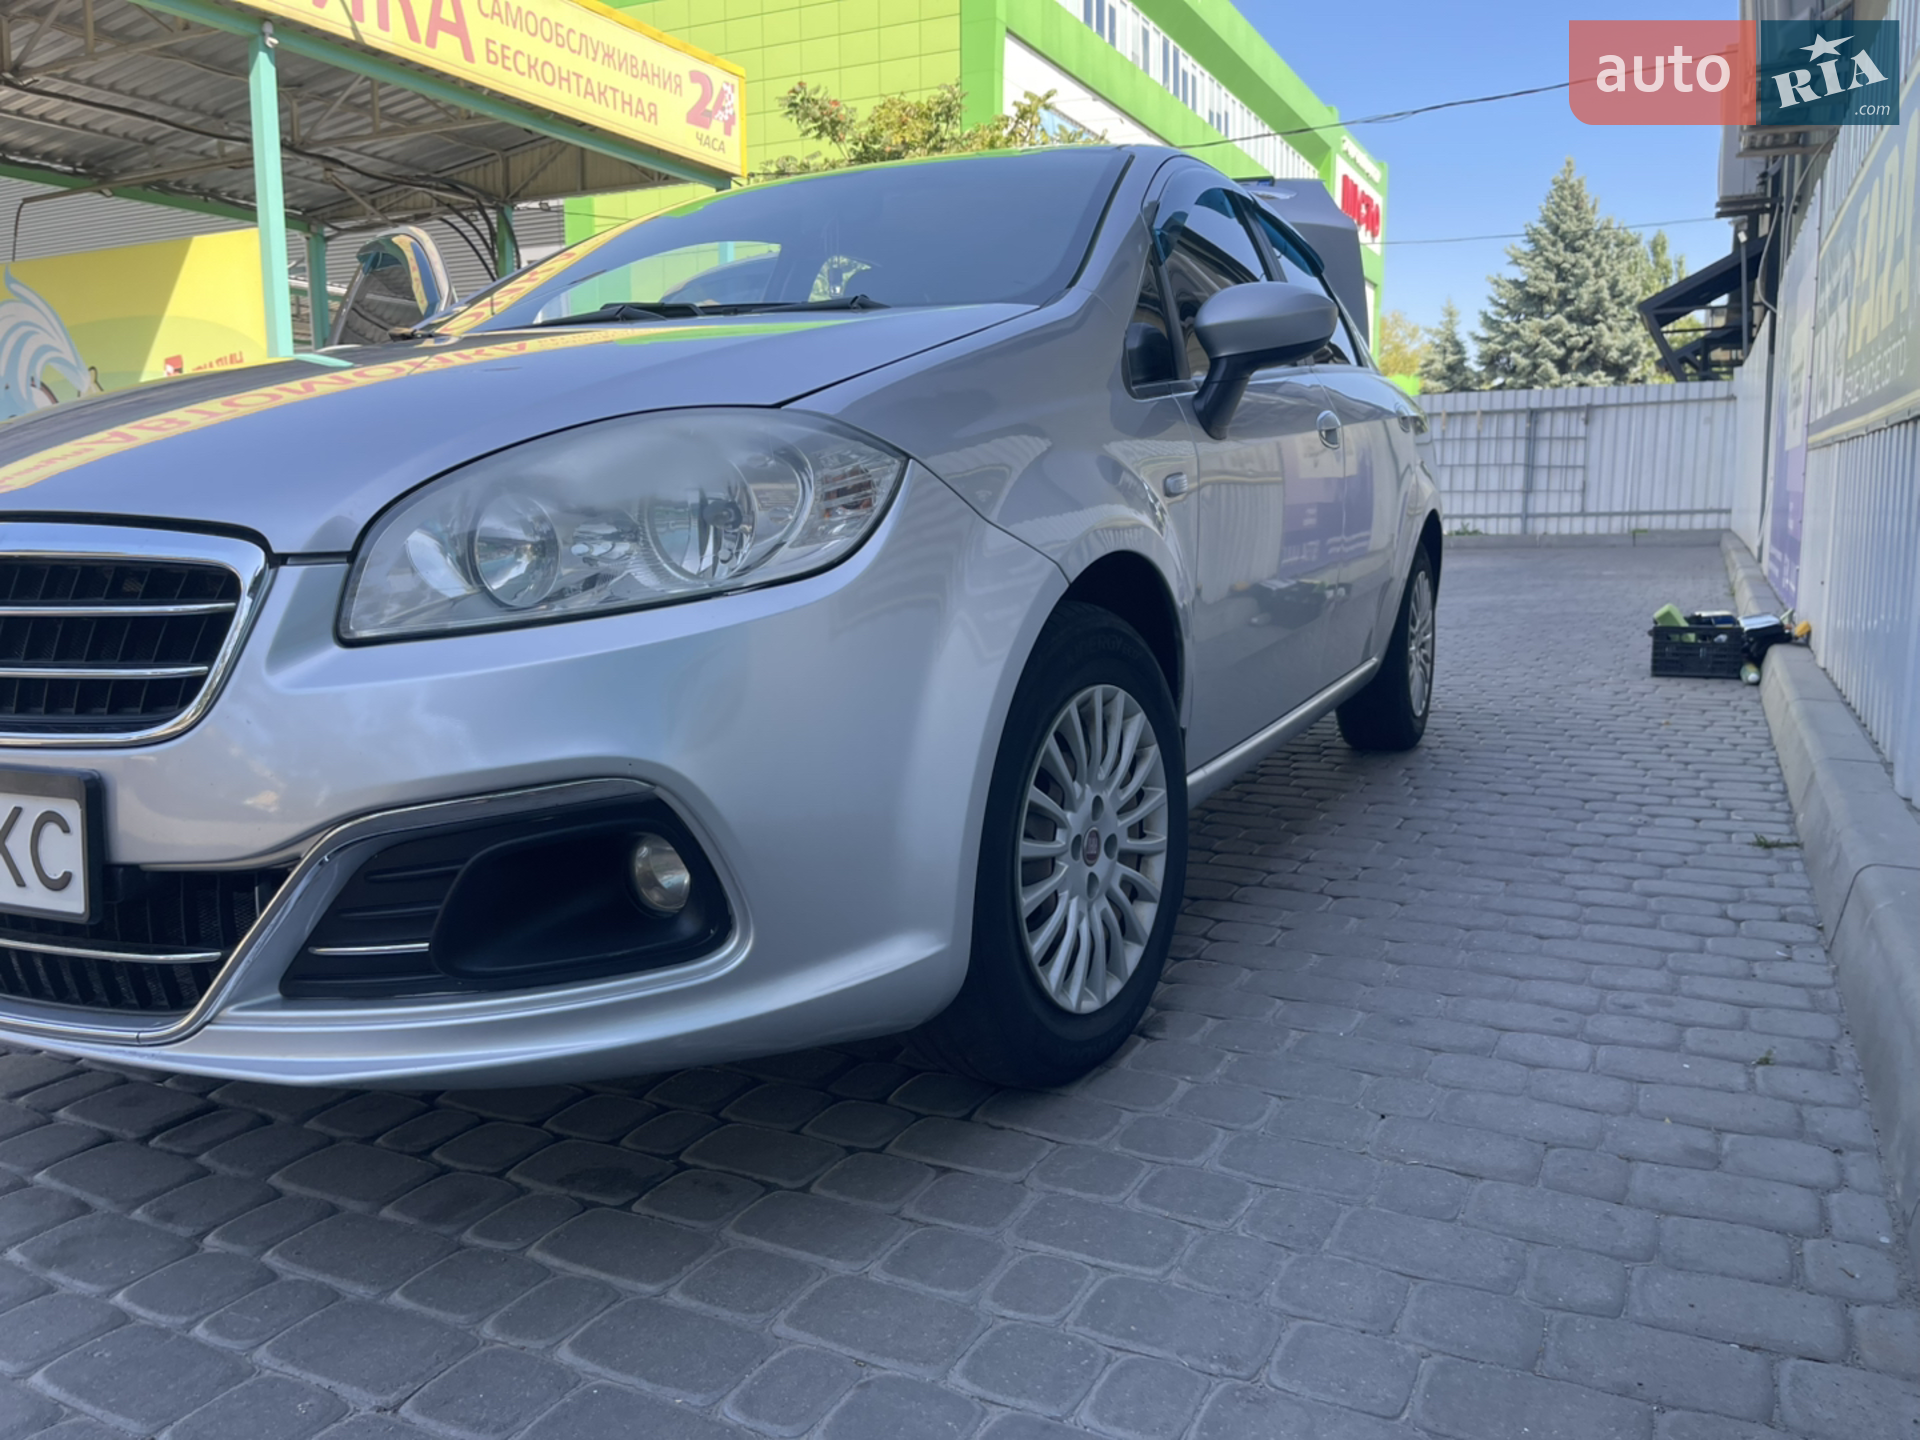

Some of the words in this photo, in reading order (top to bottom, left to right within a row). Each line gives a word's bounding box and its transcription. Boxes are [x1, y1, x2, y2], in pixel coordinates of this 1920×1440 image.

[477, 0, 683, 97] САМООБСЛУЖИВАНИЯ
[485, 38, 658, 126] БЕСКОНТАКТНАЯ
[686, 69, 736, 137] 24
[696, 131, 726, 154] ЧАСА
